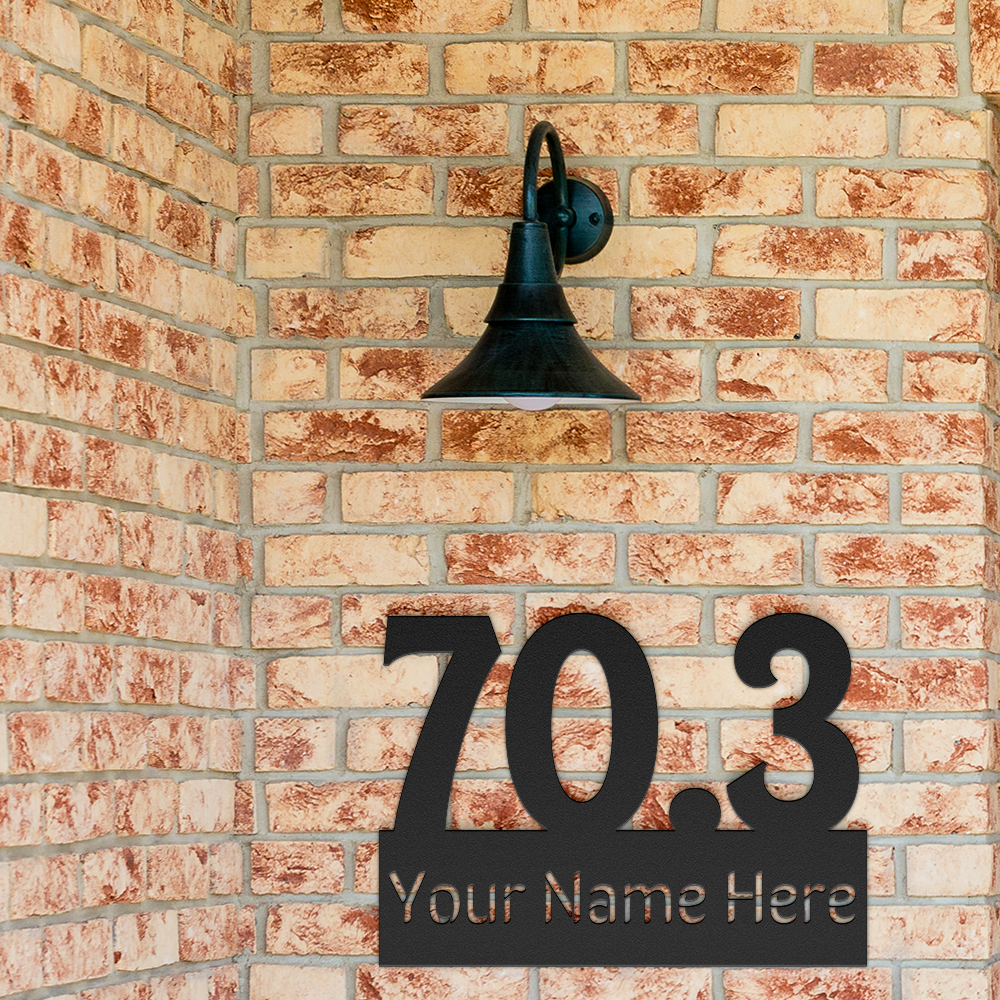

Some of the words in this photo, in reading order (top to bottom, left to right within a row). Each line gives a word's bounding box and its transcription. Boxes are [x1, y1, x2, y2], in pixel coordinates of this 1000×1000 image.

[384, 613, 860, 832] 70.3
[388, 871, 526, 924] Your
[544, 871, 706, 924] Name
[727, 871, 857, 924] Here
